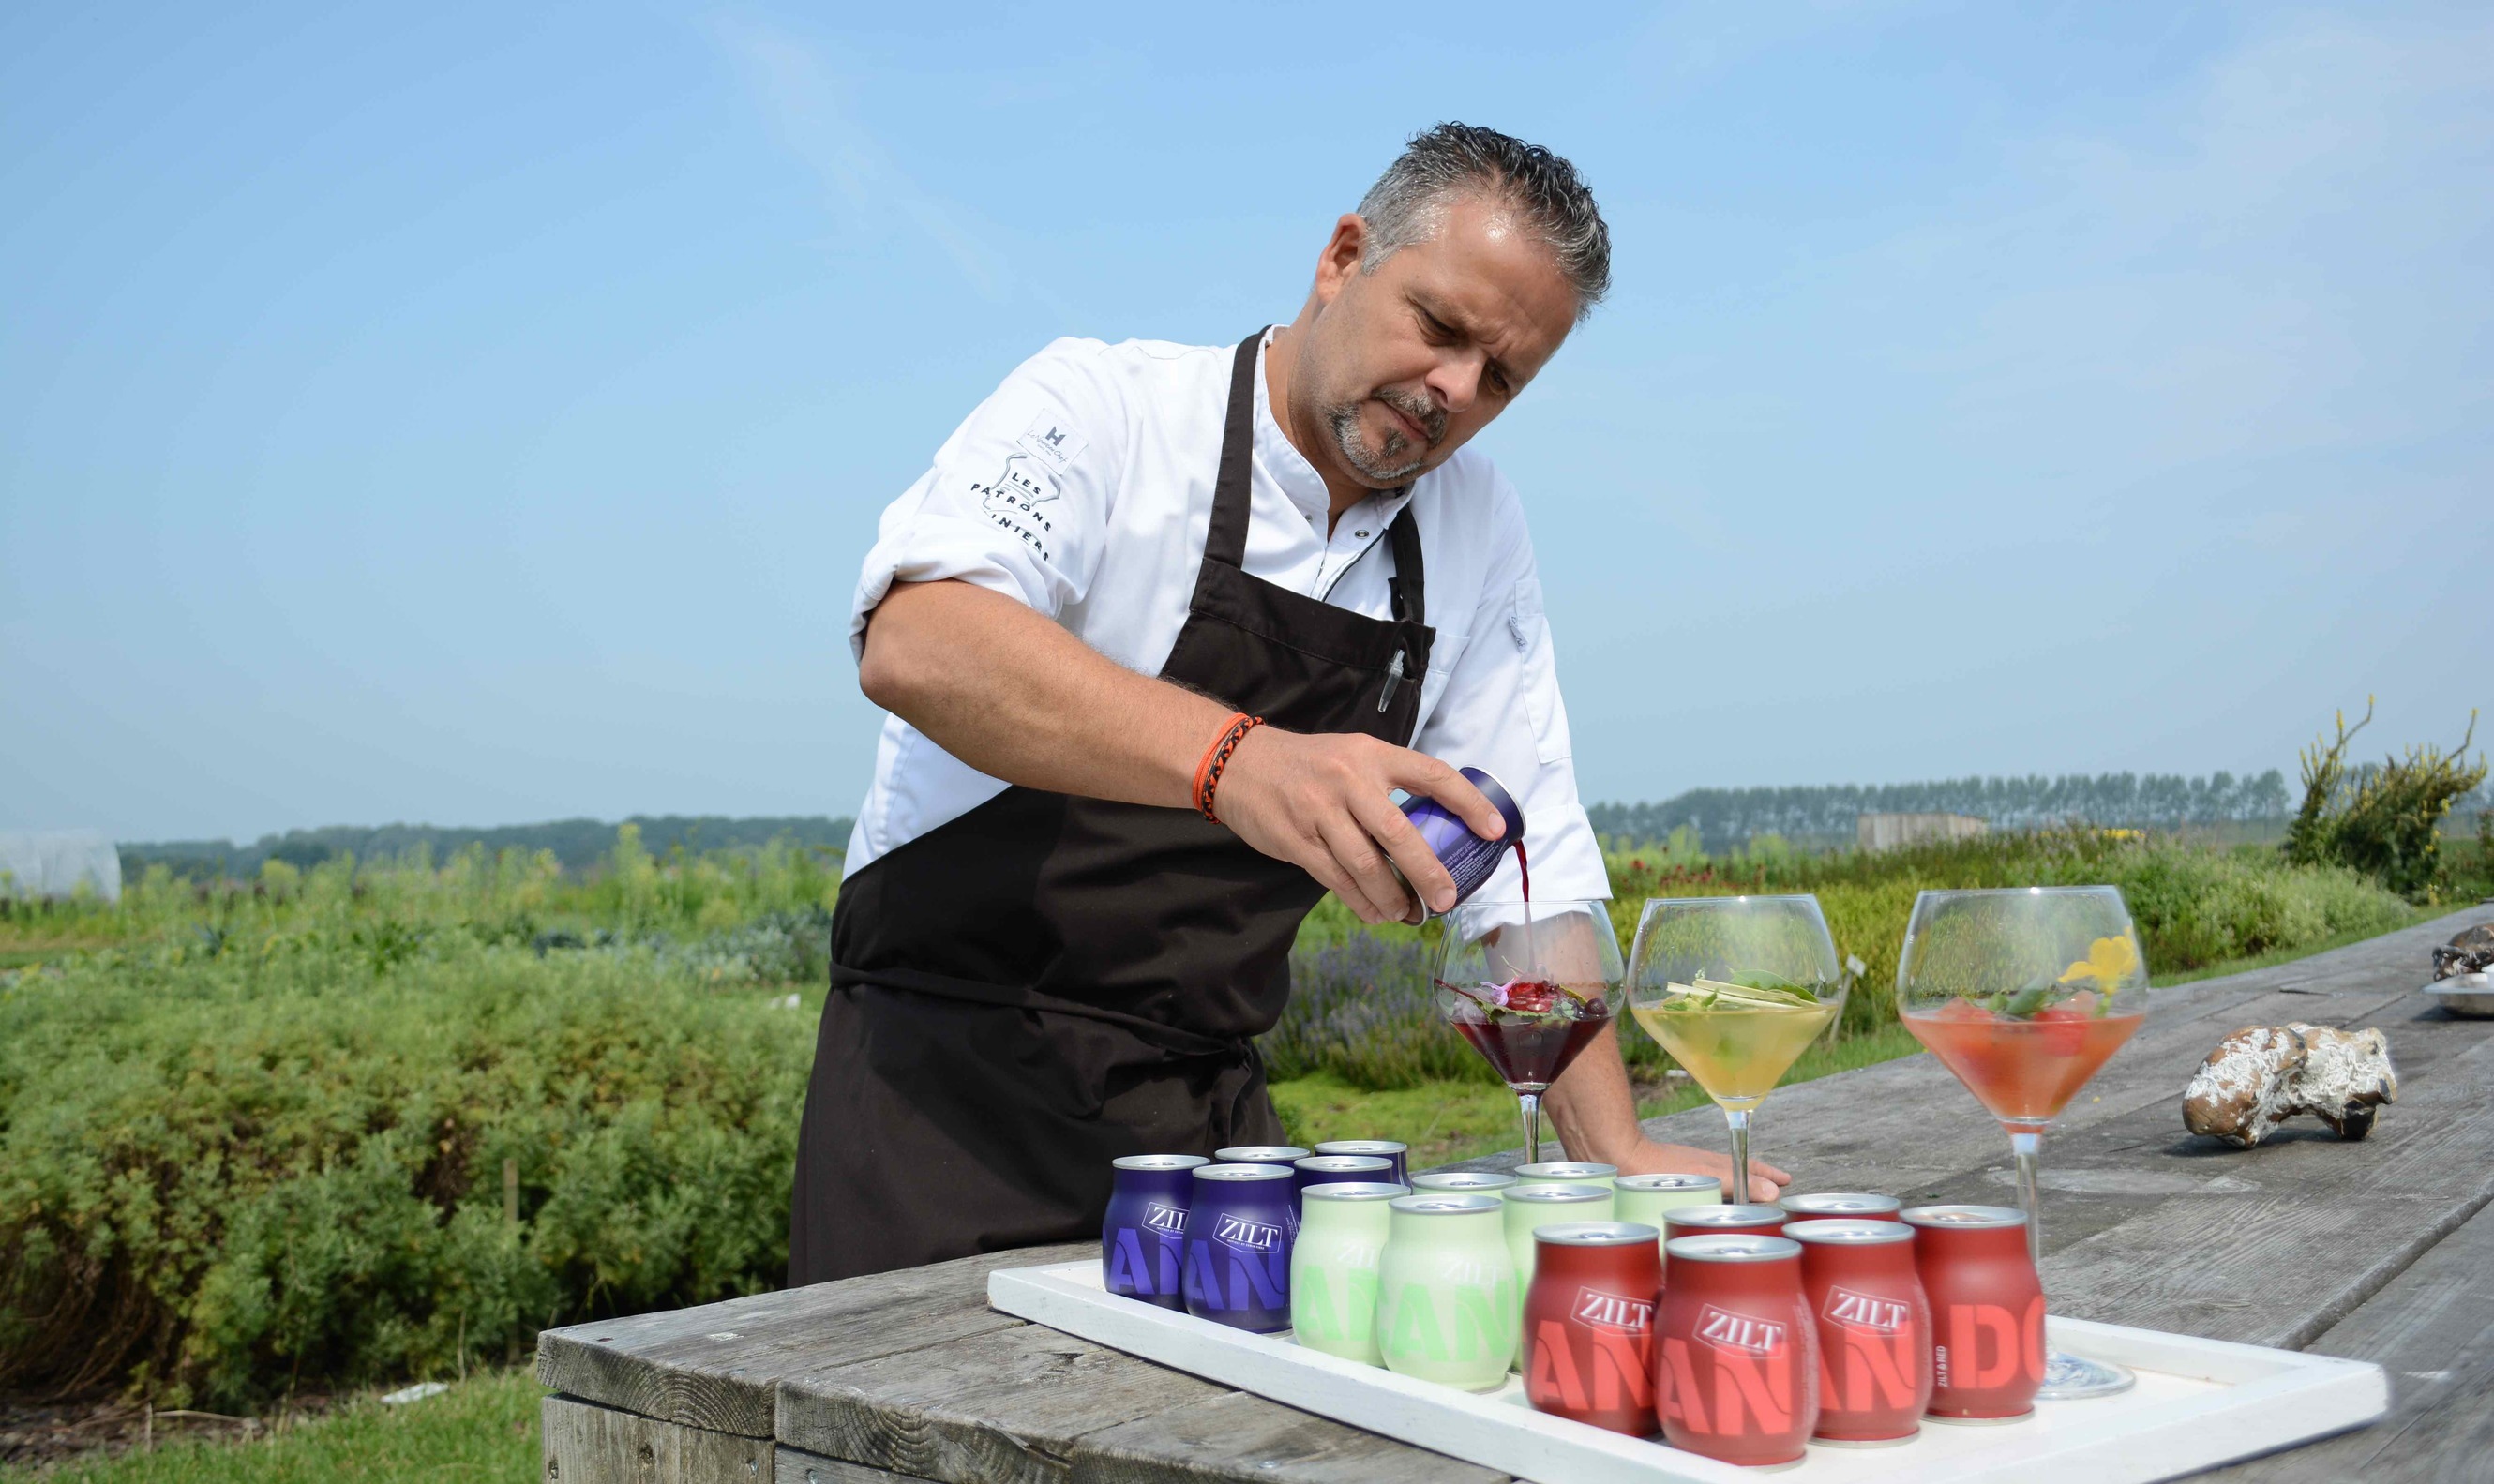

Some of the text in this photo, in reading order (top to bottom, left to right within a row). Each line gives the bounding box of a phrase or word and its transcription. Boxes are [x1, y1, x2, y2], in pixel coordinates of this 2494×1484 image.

[1054, 450, 1068, 463] Chef
[1012, 472, 1041, 495] LES
[970, 483, 1052, 532] PATRONS
[1220, 1219, 1278, 1248] ZILT
[1443, 1252, 1502, 1287] ZILT
[1580, 1293, 1652, 1328] ZILT
[1831, 1292, 1906, 1329] ZILT
[1702, 1311, 1782, 1351] ZILT
[1935, 1345, 1946, 1363] RED
[1936, 1370, 1948, 1387] ZILT
